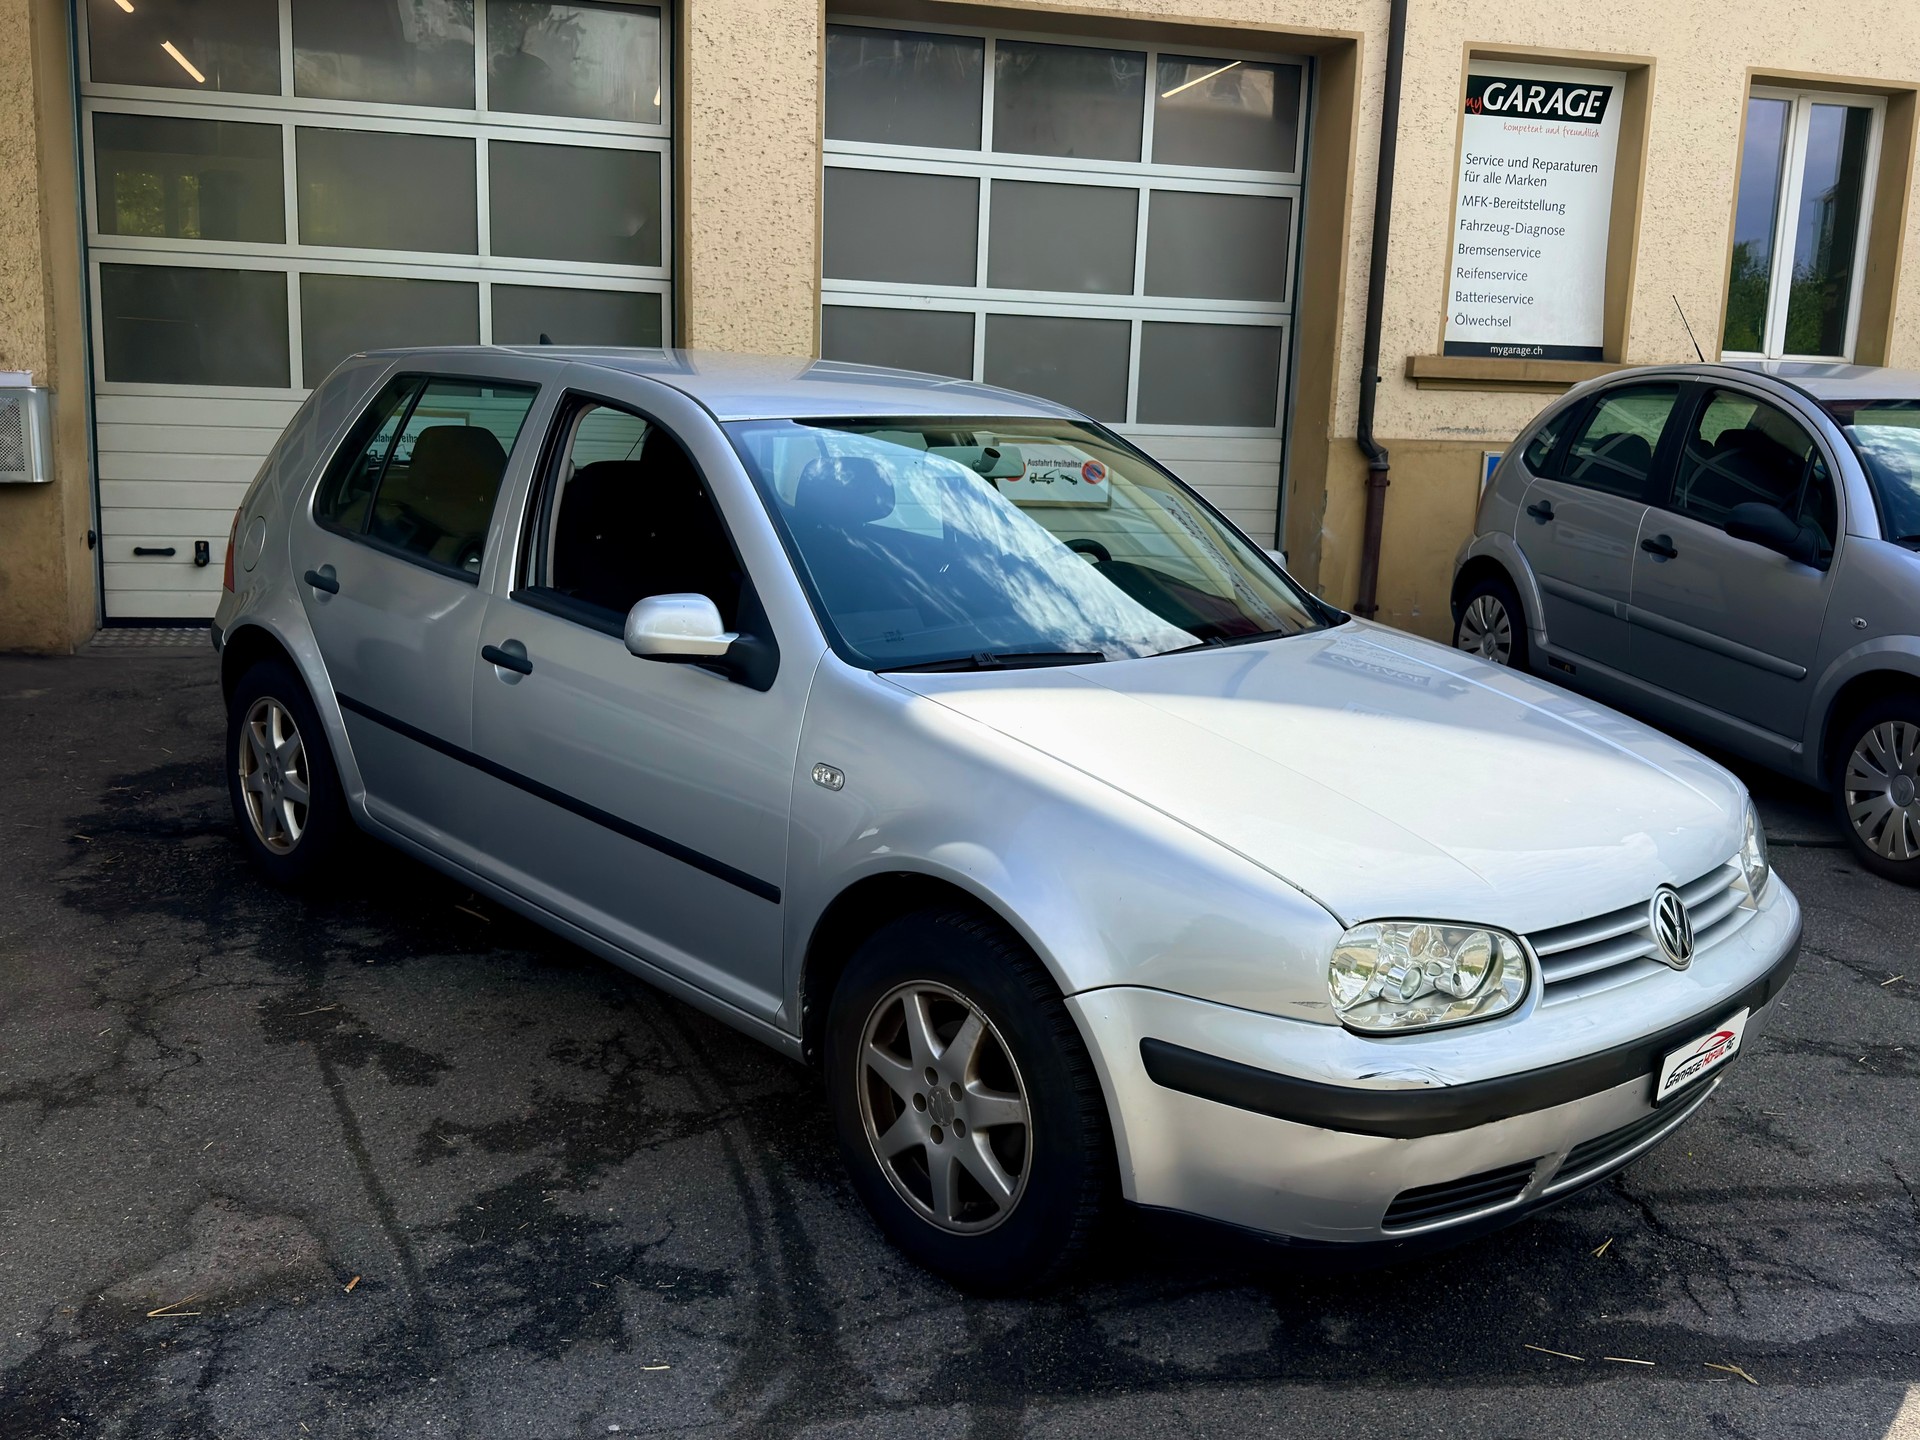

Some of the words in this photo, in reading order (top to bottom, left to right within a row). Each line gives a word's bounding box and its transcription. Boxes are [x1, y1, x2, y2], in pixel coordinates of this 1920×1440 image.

[1503, 122, 1543, 136] kompetent
[1545, 125, 1560, 135] und
[1562, 125, 1600, 139] freundlich
[1465, 153, 1504, 168] Service
[1507, 155, 1529, 169] und
[1532, 157, 1598, 174] Reparaturen
[1464, 171, 1481, 184] für
[1483, 173, 1502, 185] alle
[1505, 174, 1547, 187] Marken
[1462, 195, 1566, 215] MFK-Bereitstellung
[1460, 219, 1566, 238] Fahrzeug-Diagnose
[1458, 243, 1541, 259] Bremsenservice
[1456, 267, 1528, 282] Reifenservice
[1455, 291, 1534, 306] Batterieservice
[1455, 312, 1512, 328] Ölwechsel
[1490, 344, 1543, 357] mygarage.ch
[1027, 458, 1053, 467] Ausfahrt
[1053, 459, 1082, 468] freihalten
